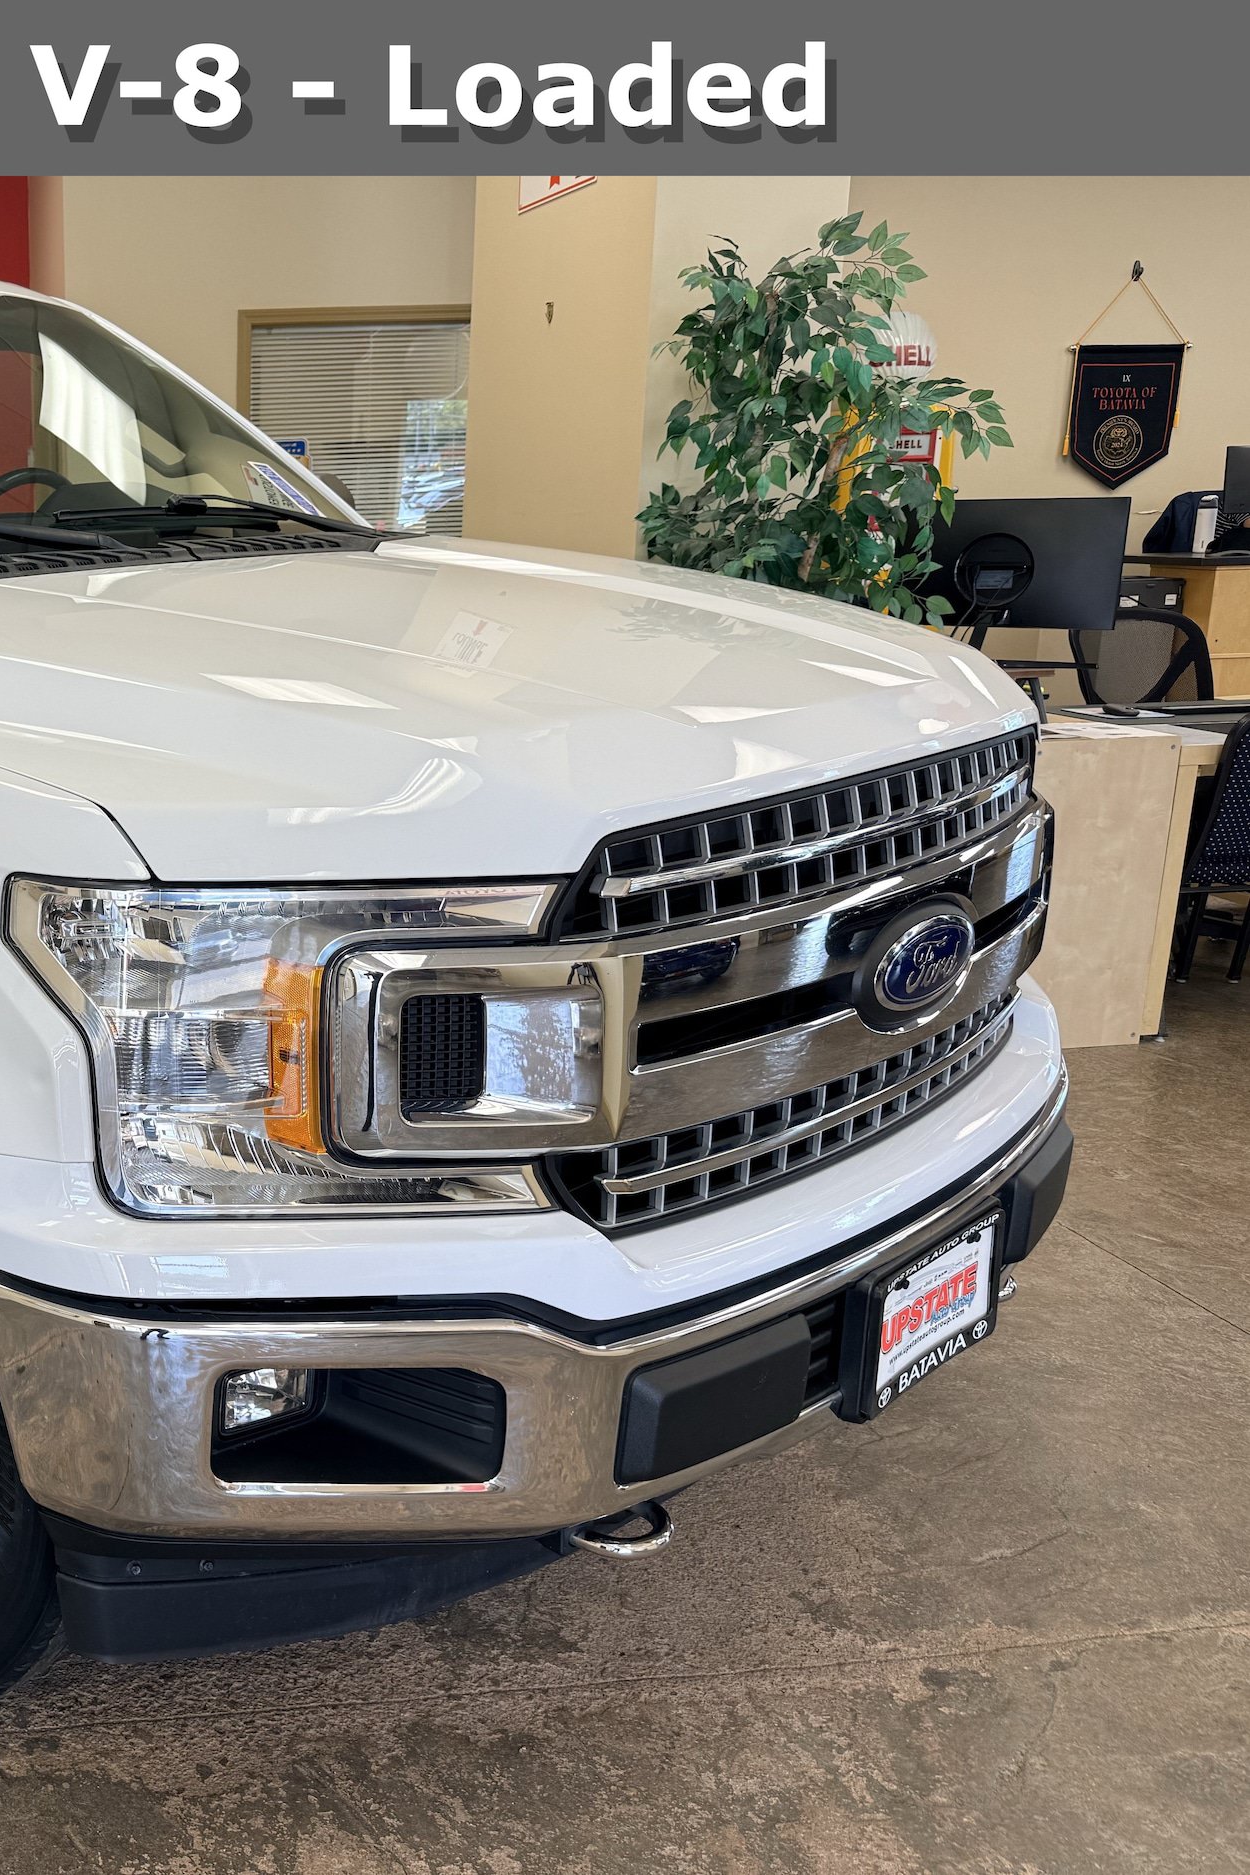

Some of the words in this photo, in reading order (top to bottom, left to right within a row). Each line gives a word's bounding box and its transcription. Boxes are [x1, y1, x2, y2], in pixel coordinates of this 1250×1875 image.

[869, 344, 931, 367] HELL
[1092, 387, 1137, 398] TOYOTA
[1141, 386, 1158, 398] OF
[1099, 399, 1146, 410] BATAVIA
[889, 439, 922, 450] HELL
[906, 935, 961, 994] Ford
[930, 1237, 960, 1261] AUTO
[961, 1213, 1000, 1241] GROUP
[881, 1261, 979, 1354] UPSTATE
[898, 1333, 967, 1394] BATAVIA
